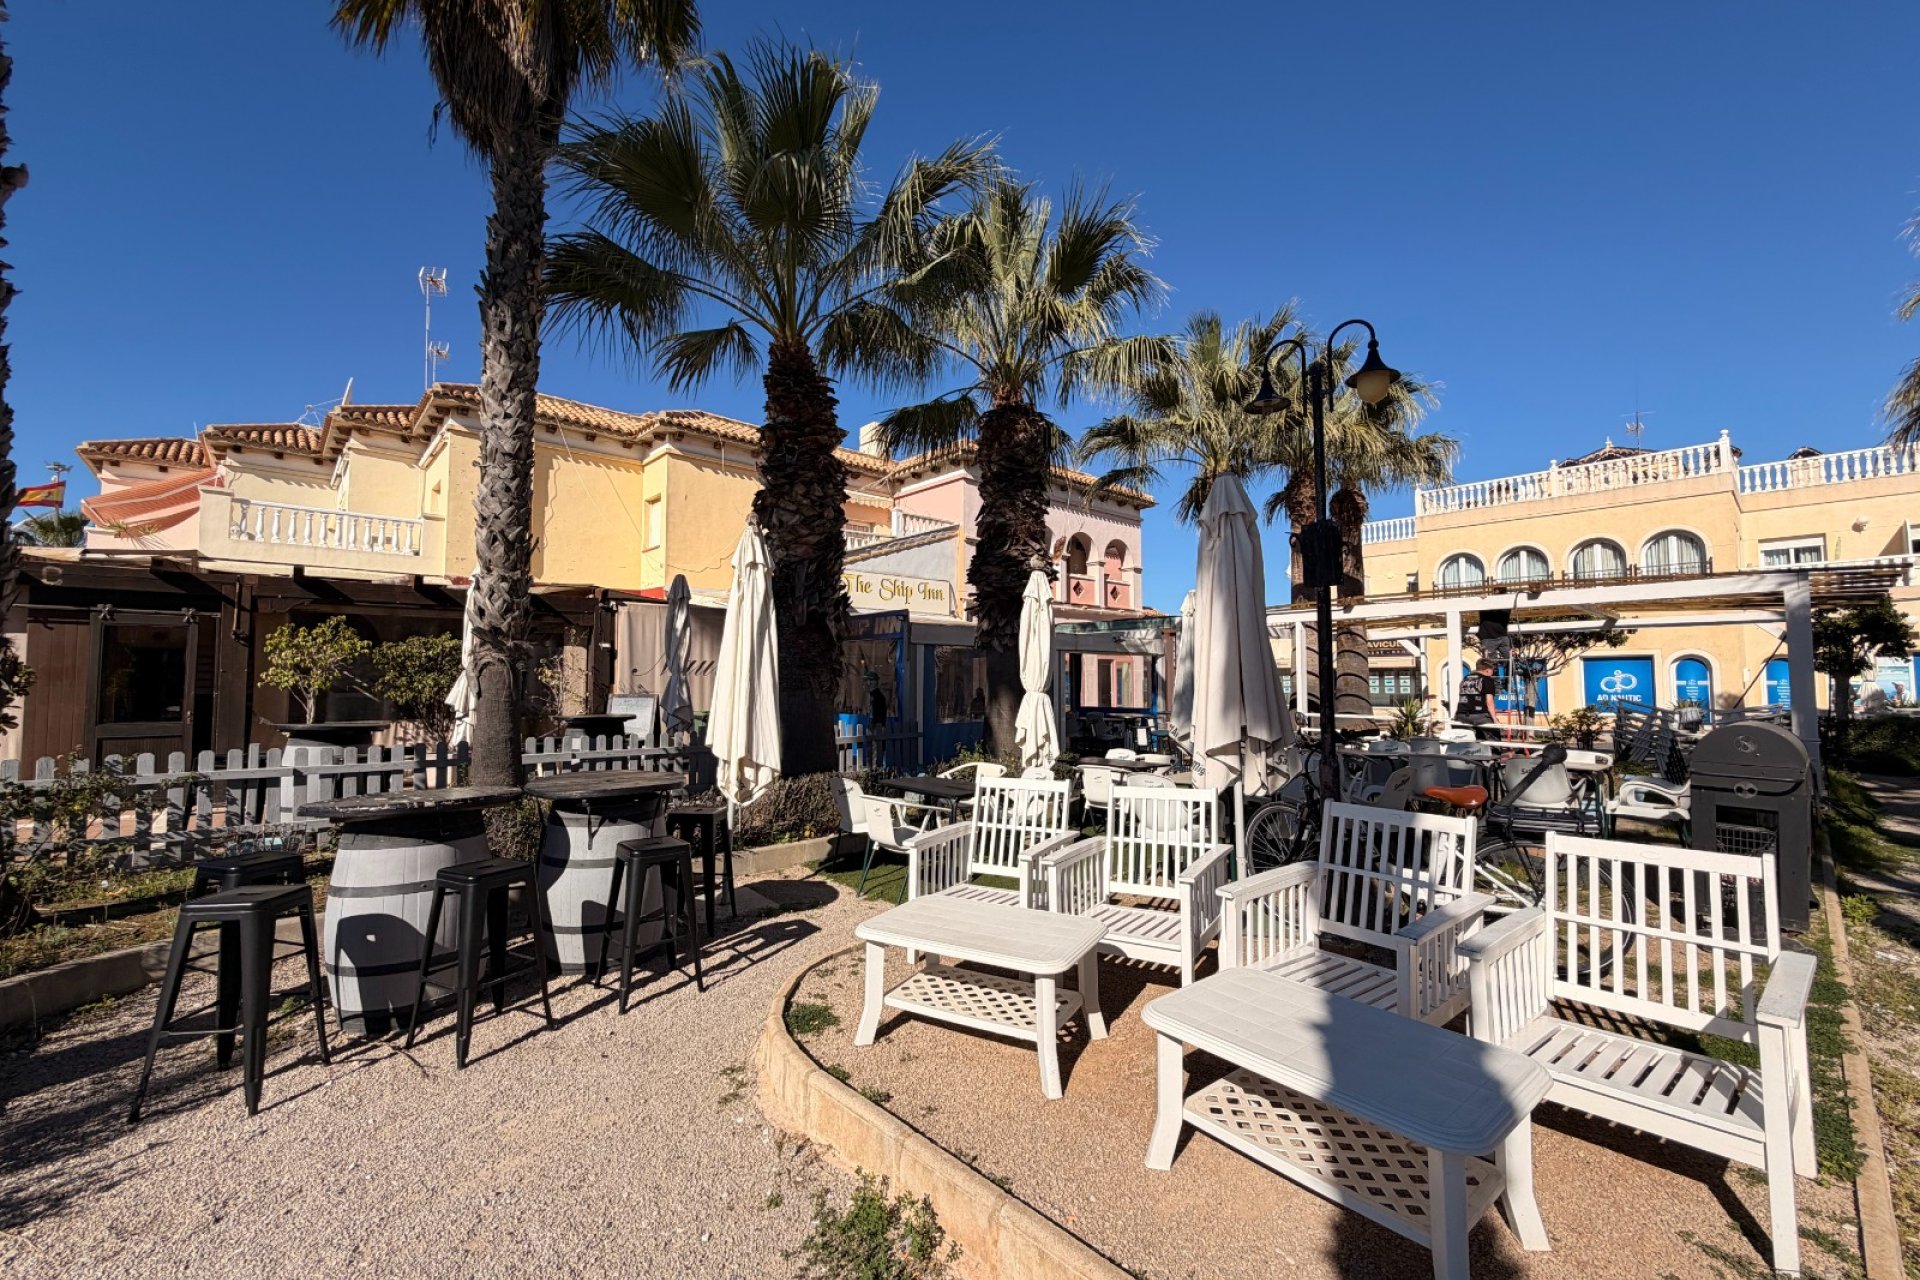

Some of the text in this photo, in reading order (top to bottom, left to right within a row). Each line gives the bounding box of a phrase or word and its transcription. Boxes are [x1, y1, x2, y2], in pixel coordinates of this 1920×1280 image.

[841, 573, 945, 604] The Ship Inn
[874, 616, 902, 635] INN
[1596, 693, 1609, 702] AD
